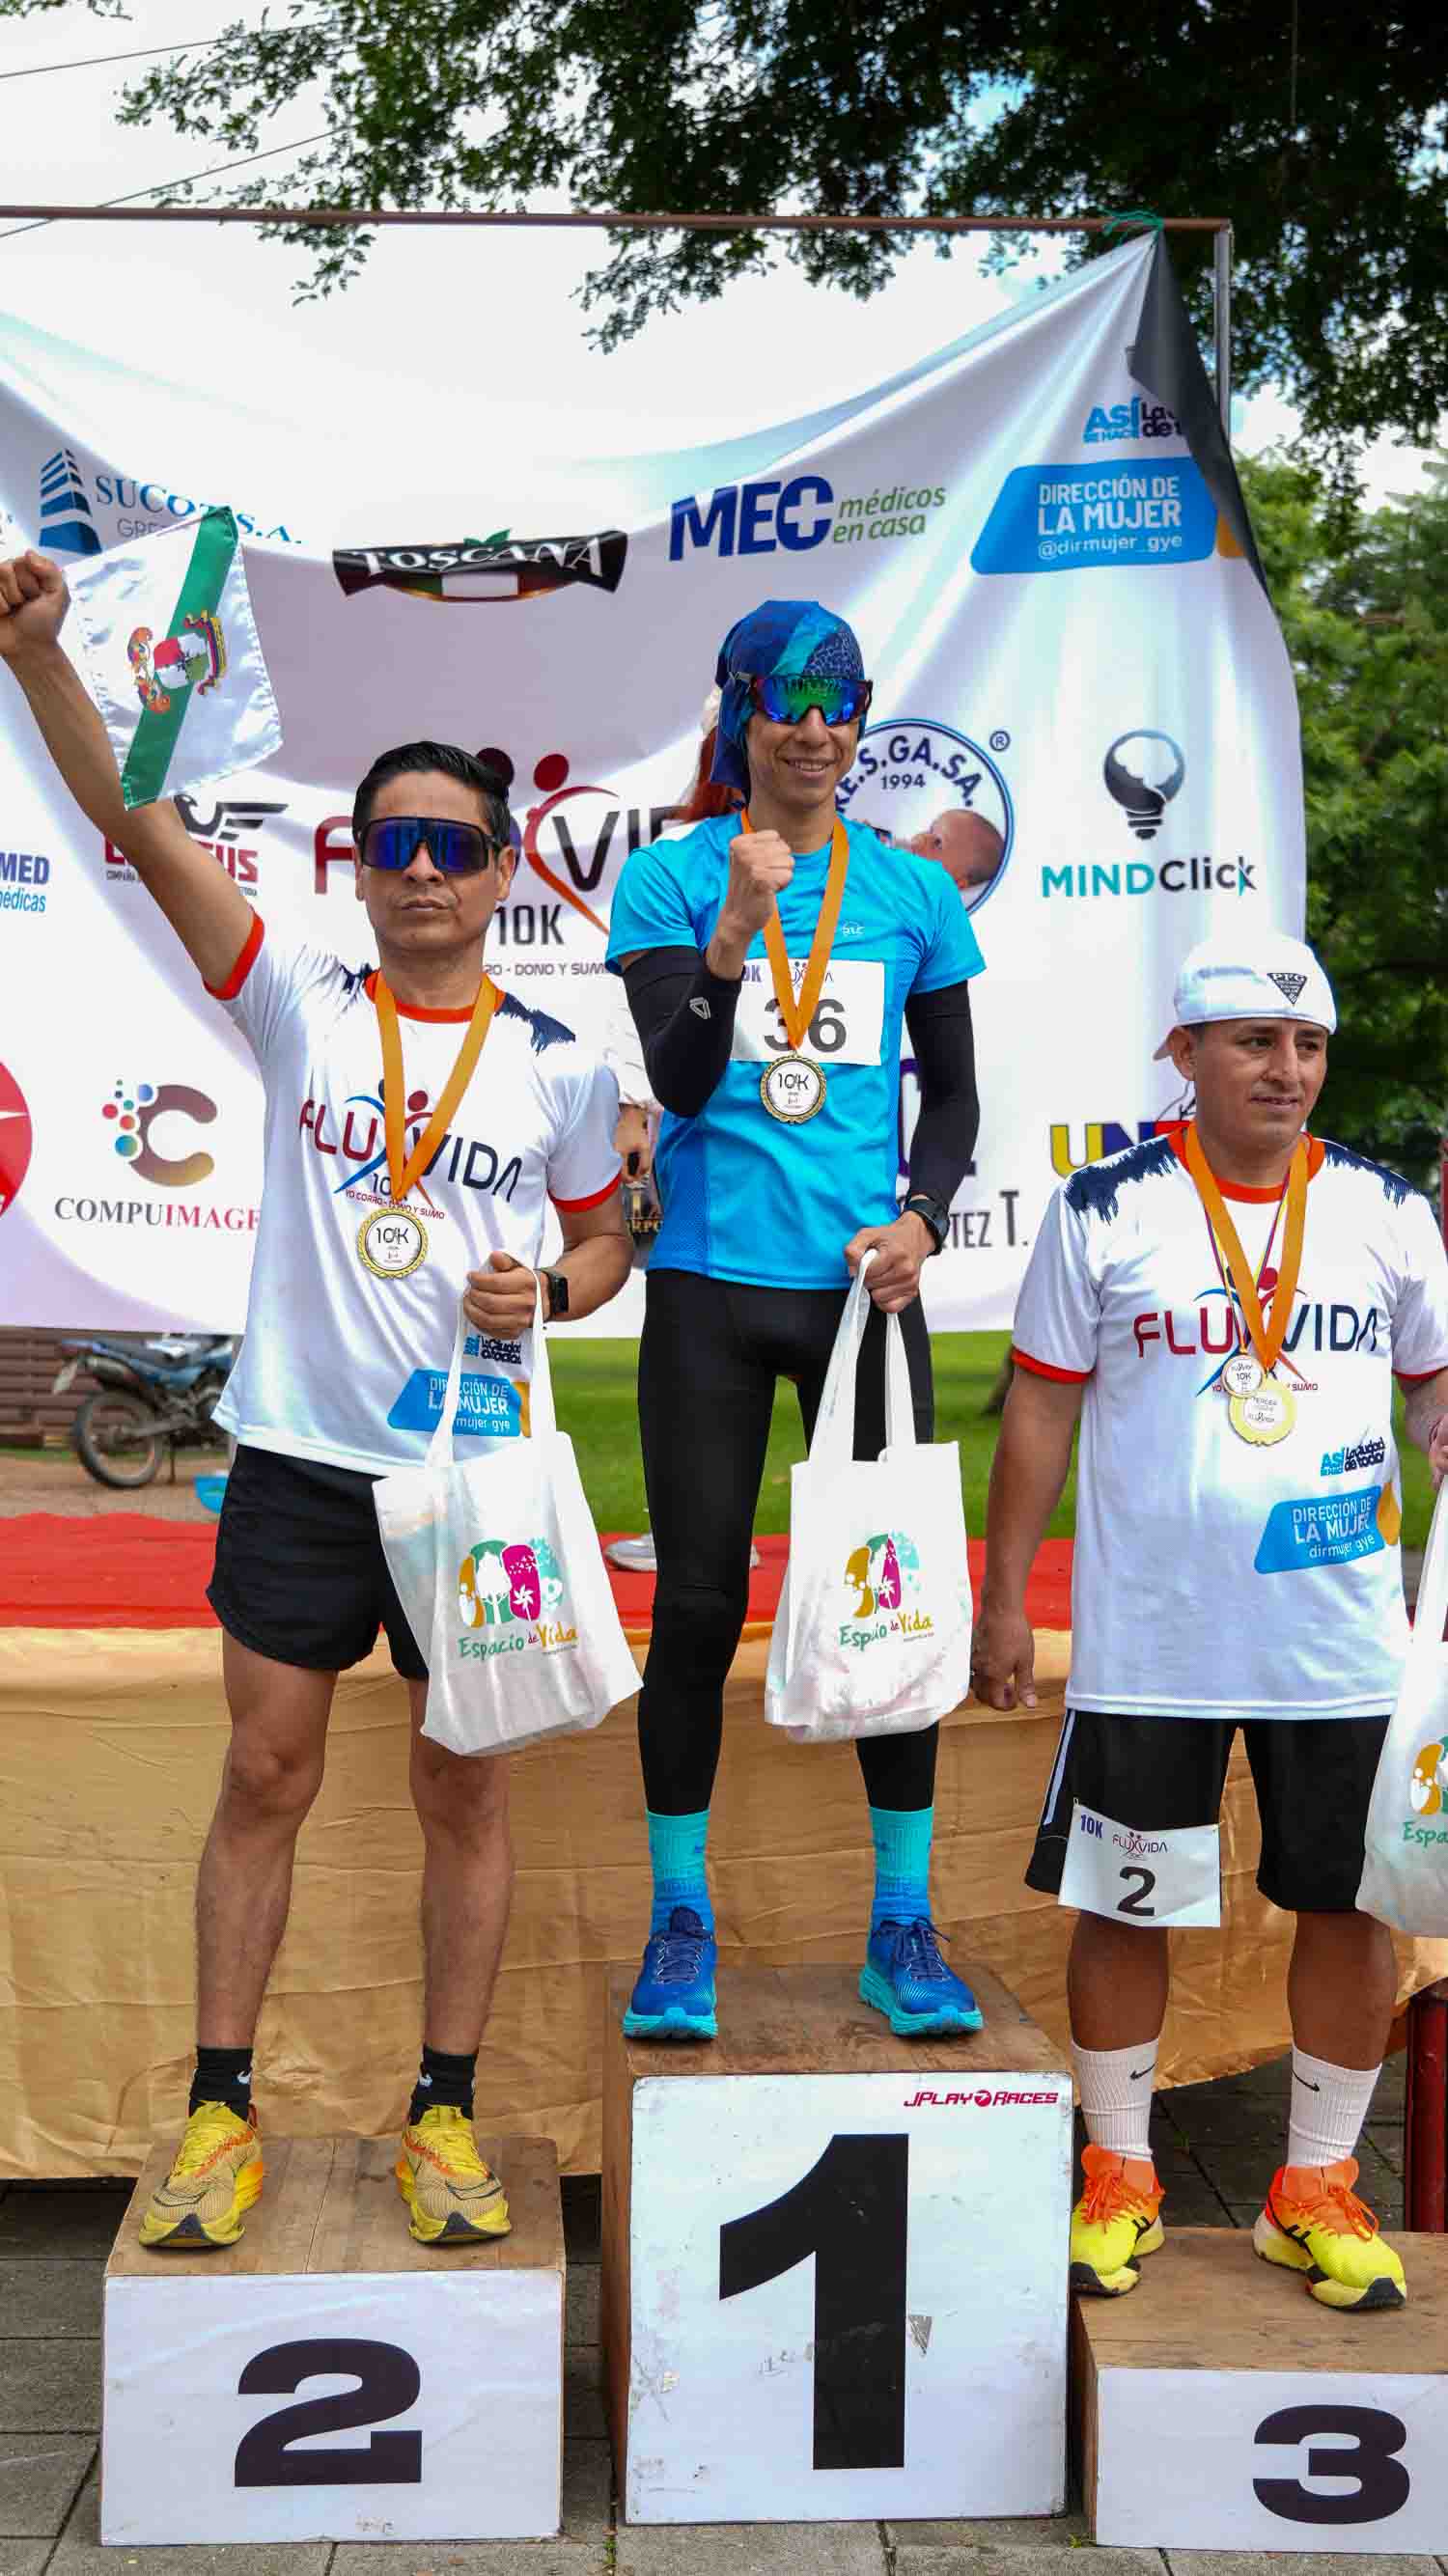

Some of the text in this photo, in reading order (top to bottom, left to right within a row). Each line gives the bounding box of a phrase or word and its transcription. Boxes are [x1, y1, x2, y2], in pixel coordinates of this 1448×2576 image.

[1039, 474, 1180, 506] DIRECCIÓN DE
[669, 476, 946, 562] MEC médicos
[833, 512, 927, 543] en casa
[1037, 499, 1183, 536] LA MUJER
[352, 536, 603, 577] TOSCANA
[1038, 533, 1183, 560] @dirmujer_gye
[880, 773, 926, 789] 1994
[1041, 855, 1257, 898] MINDClick
[494, 903, 565, 946] 10K
[515, 963, 555, 976] DONO
[560, 963, 567, 975] Y
[571, 962, 609, 975] SUM
[764, 997, 847, 1053] 36
[420, 1207, 445, 1220] SUMO
[430, 1377, 510, 1398] DIRCIÓN DE
[1292, 1383, 1319, 1392] SUMO
[459, 1396, 510, 1416] MUJER
[1293, 1497, 1372, 1524] DIRECCIÓN DE
[1294, 1523, 1321, 1544] LA
[897, 1609, 933, 1634] Vida
[458, 1628, 525, 1661] Espacio
[536, 1620, 578, 1649] Vida
[1080, 1814, 1104, 1840] 10K
[1403, 1820, 1448, 1847] Espa
[1117, 1866, 1156, 1917] 2
[904, 2091, 1059, 2107] JPLAY RACES
[719, 2133, 908, 2471] 1
[235, 2338, 423, 2487] 2
[1253, 2404, 1410, 2525] 3
